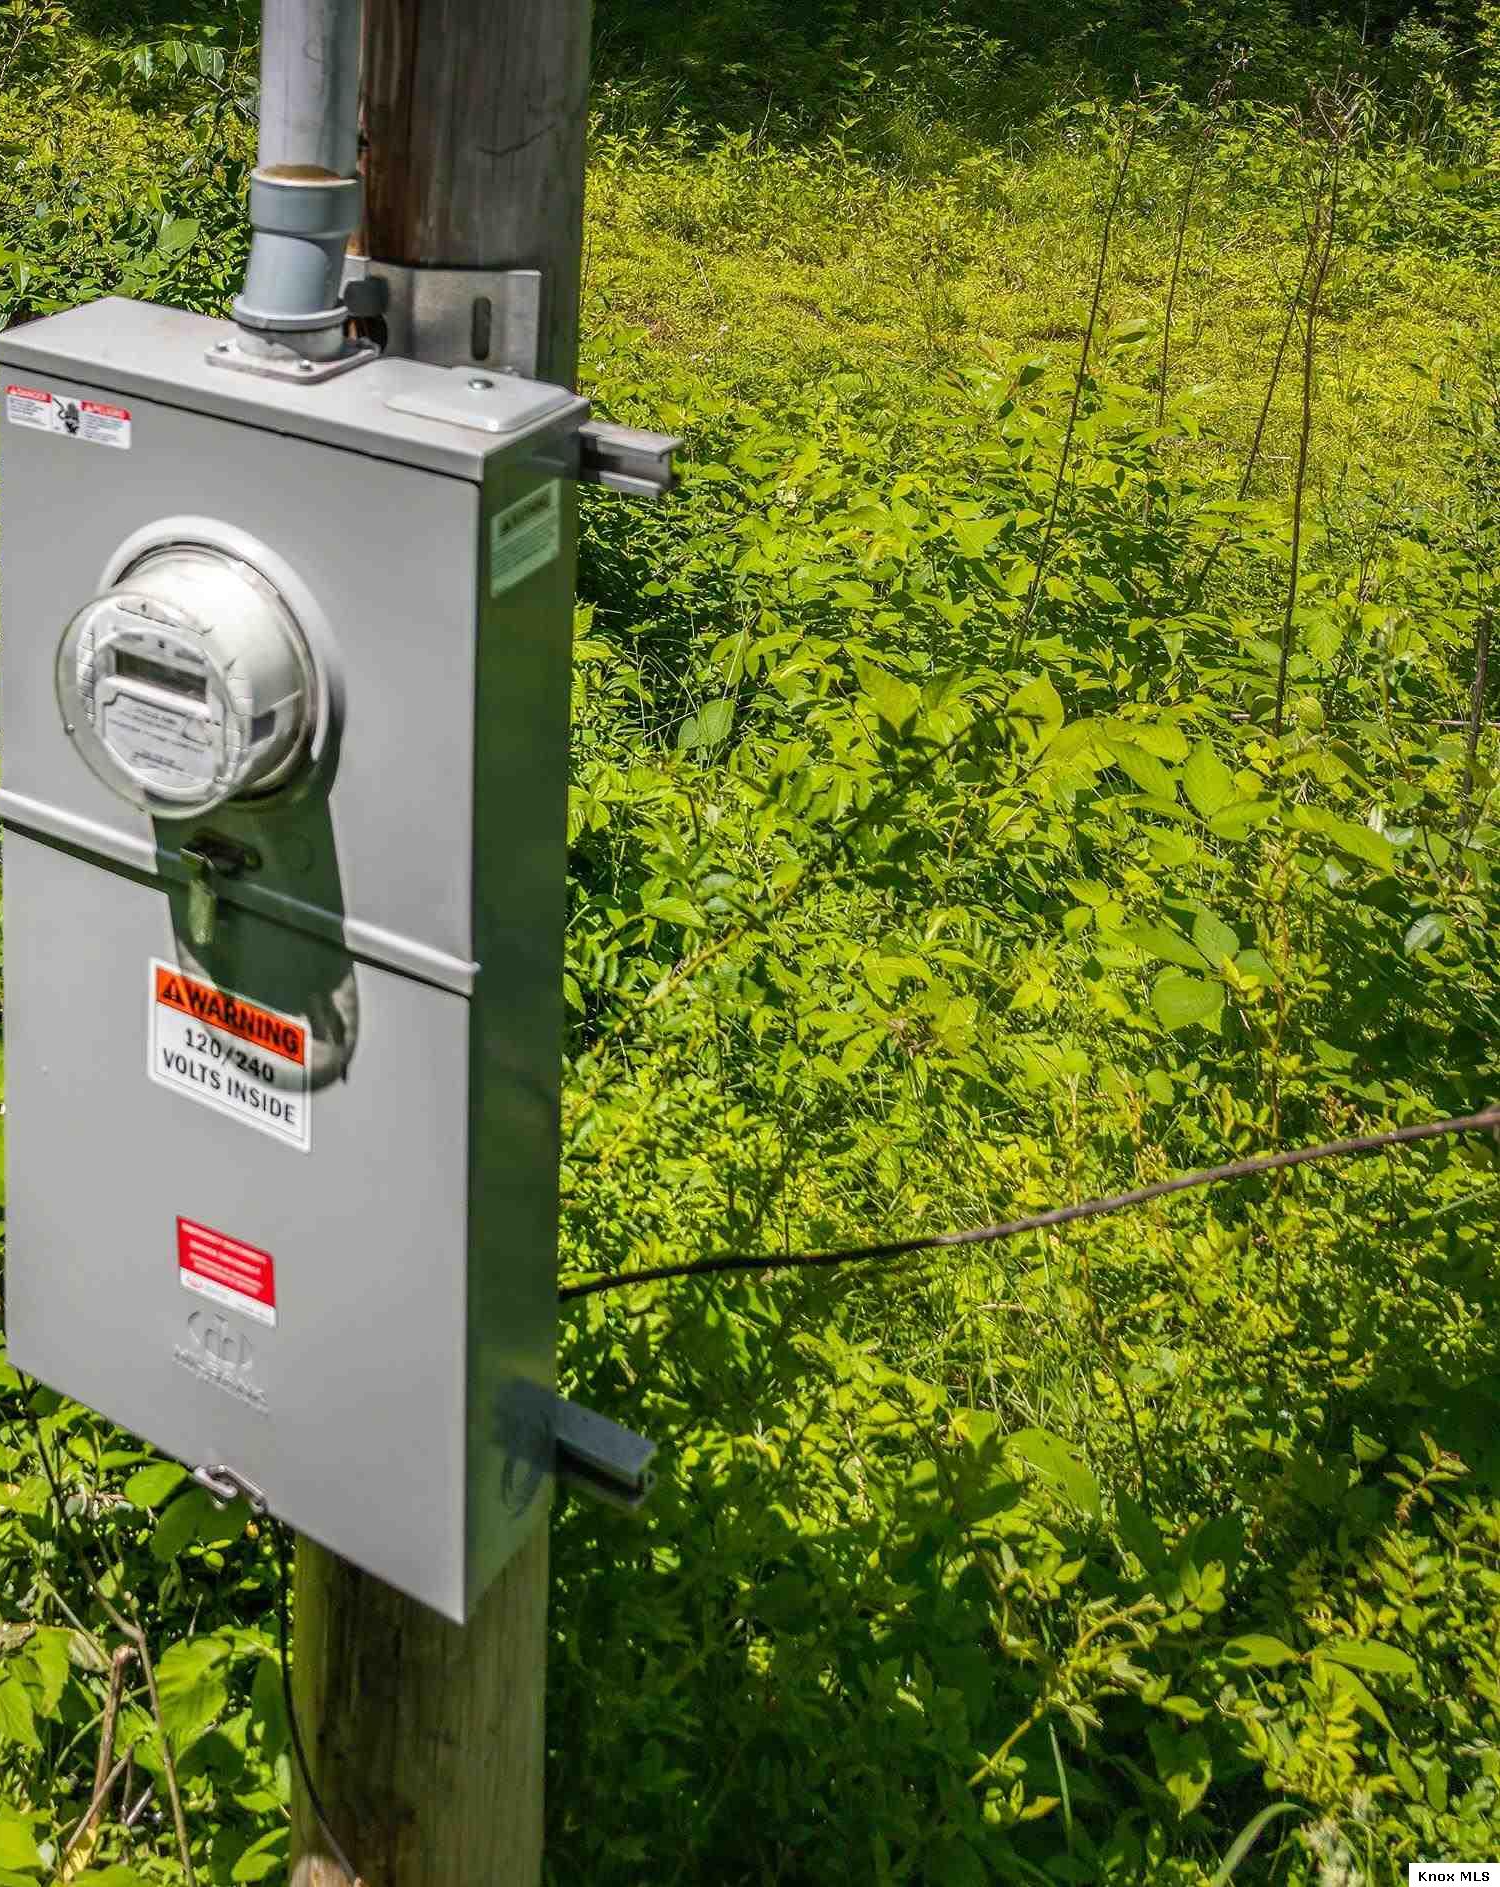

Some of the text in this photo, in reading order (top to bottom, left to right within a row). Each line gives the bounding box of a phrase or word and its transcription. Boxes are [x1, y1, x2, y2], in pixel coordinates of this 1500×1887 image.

[189, 989, 299, 1054] WARNING
[163, 1048, 296, 1125] VOLTS INSIDE
[185, 1028, 274, 1083] 120/240
